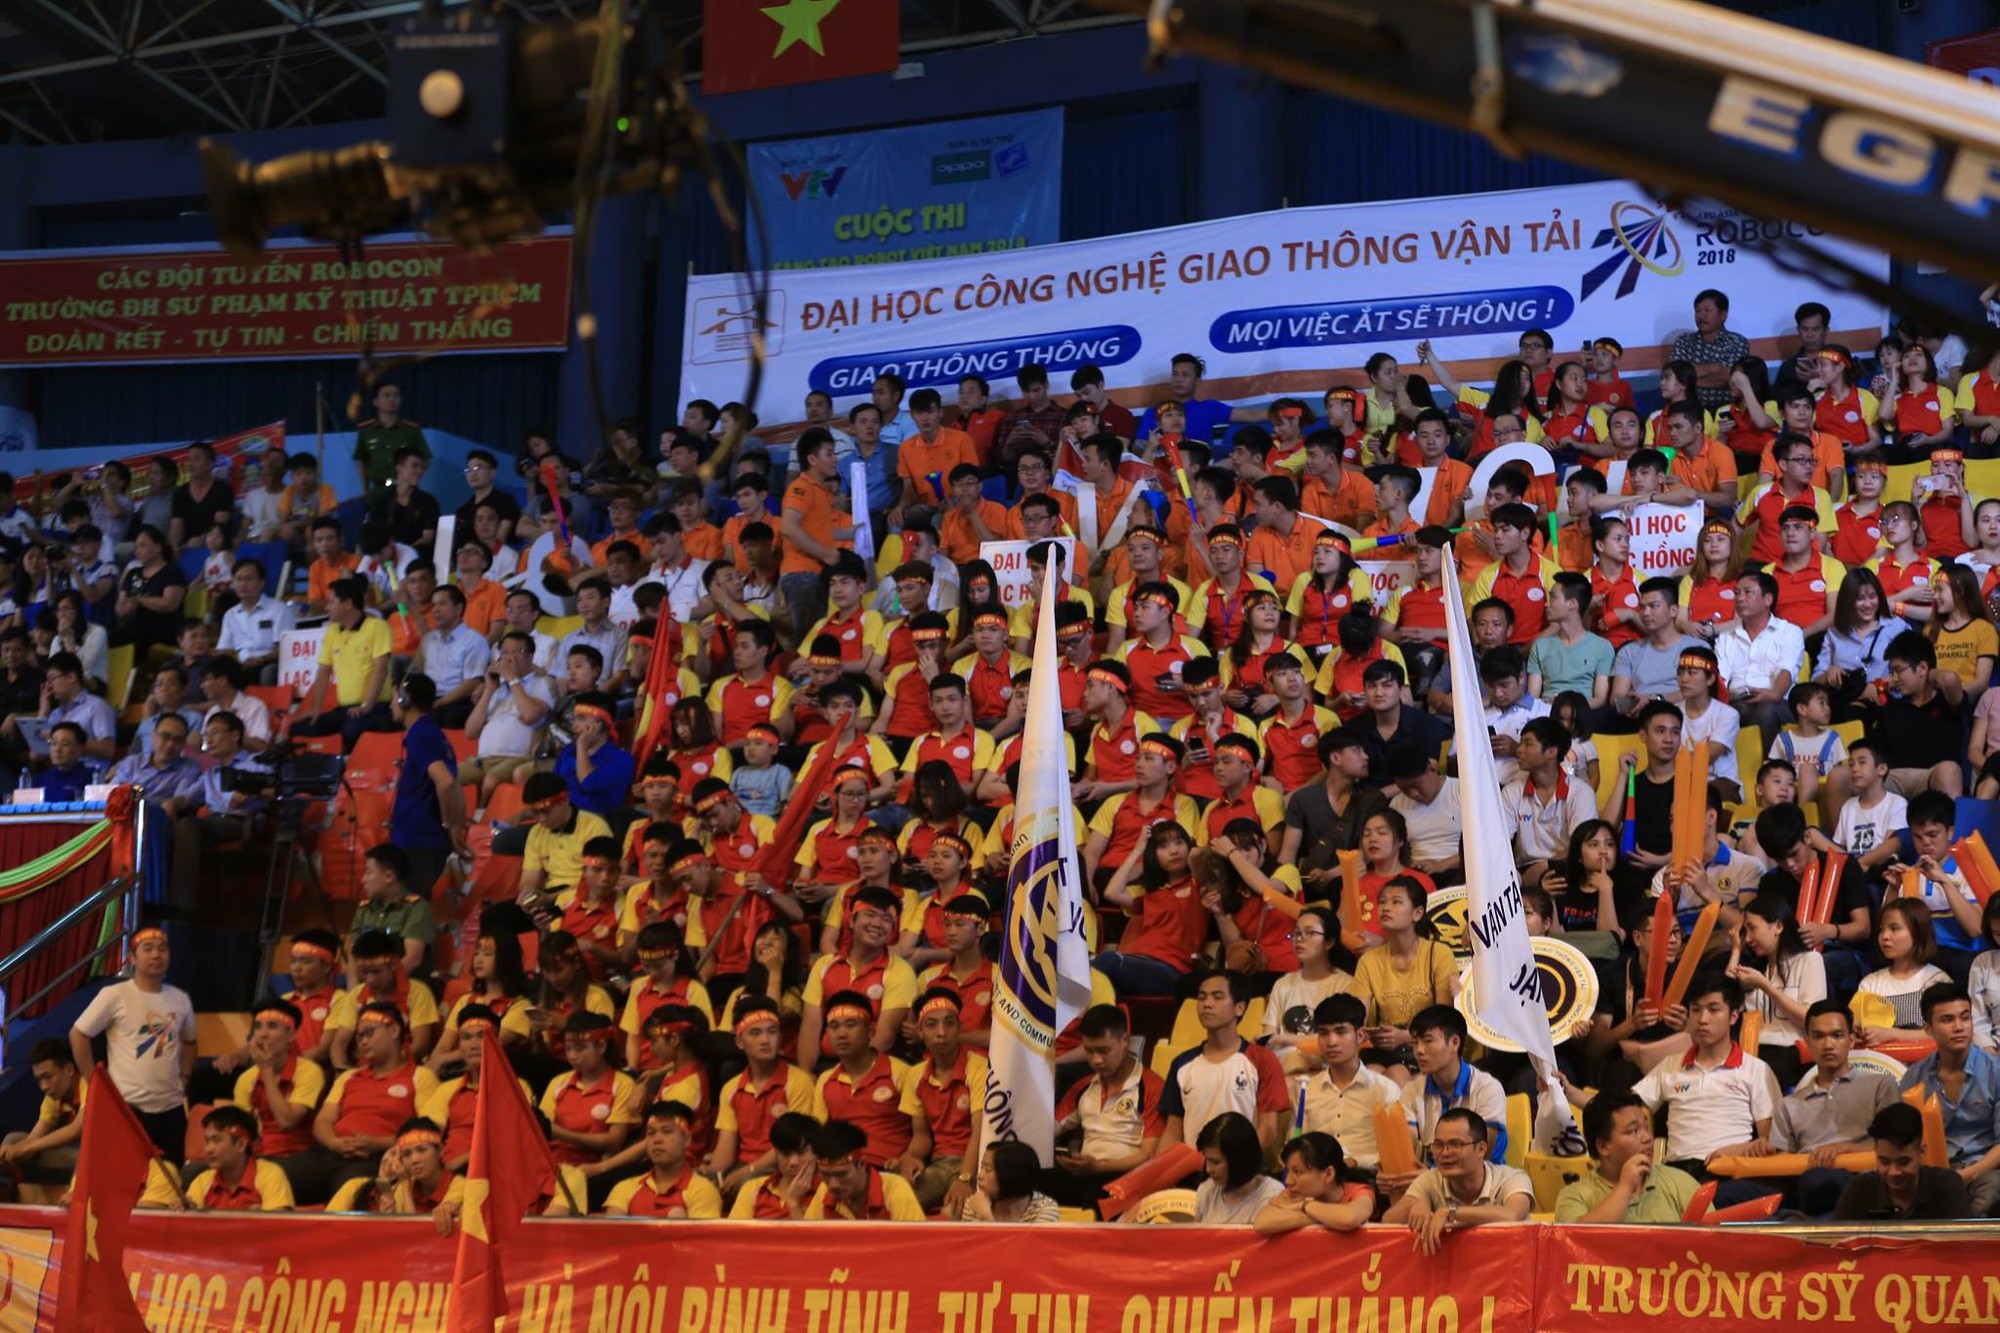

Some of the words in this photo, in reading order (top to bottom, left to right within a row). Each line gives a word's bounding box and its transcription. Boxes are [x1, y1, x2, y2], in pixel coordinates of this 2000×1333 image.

[780, 167, 847, 202] VTV
[834, 206, 913, 242] CUỘC
[921, 203, 966, 231] THI
[1696, 217, 1825, 247] ROBOCO
[97, 265, 150, 290] CÁC
[157, 262, 203, 291] ĐỘI
[309, 257, 444, 282] ROBOCON
[800, 297, 859, 334] ĐẠI
[871, 287, 944, 325] HỌC
[954, 273, 1055, 312] CÔNG
[1066, 251, 1167, 299] NGHỆ
[1178, 245, 1271, 285] GIAO
[1281, 229, 1419, 272] THÔNG
[1430, 219, 1511, 265] VẬN
[1522, 208, 1581, 253] TẢI
[1698, 248, 1736, 267] 2018
[122, 297, 159, 318] ĐH
[211, 292, 288, 318] PHẠM
[294, 286, 336, 311] KỸ
[341, 283, 438, 312] THUẬT
[26, 328, 105, 354] ĐOÀN
[115, 322, 167, 350] KẾT
[240, 327, 285, 347] TIN
[313, 314, 400, 344] CHIẾN
[410, 308, 513, 341] THẮNG
[1228, 318, 1281, 346] MỌI
[1288, 311, 1349, 341] VIỆC
[1395, 303, 1431, 331] SẼ
[1436, 299, 1538, 327] THÔNG
[905, 350, 1010, 381] THÔNG
[1014, 336, 1122, 366] THÔNG
[1647, 513, 1687, 538] HỌC
[993, 552, 1021, 574] ĐẠI
[1642, 541, 1696, 570] HỒNG
[998, 998, 1021, 1020] AND
[1019, 1018, 1054, 1048] COMMU
[230, 1256, 348, 1333] CÔNG
[353, 1280, 453, 1333] NGH
[1566, 1250, 1787, 1319] TRƯỜNG
[1796, 1260, 1865, 1322] SỸ
